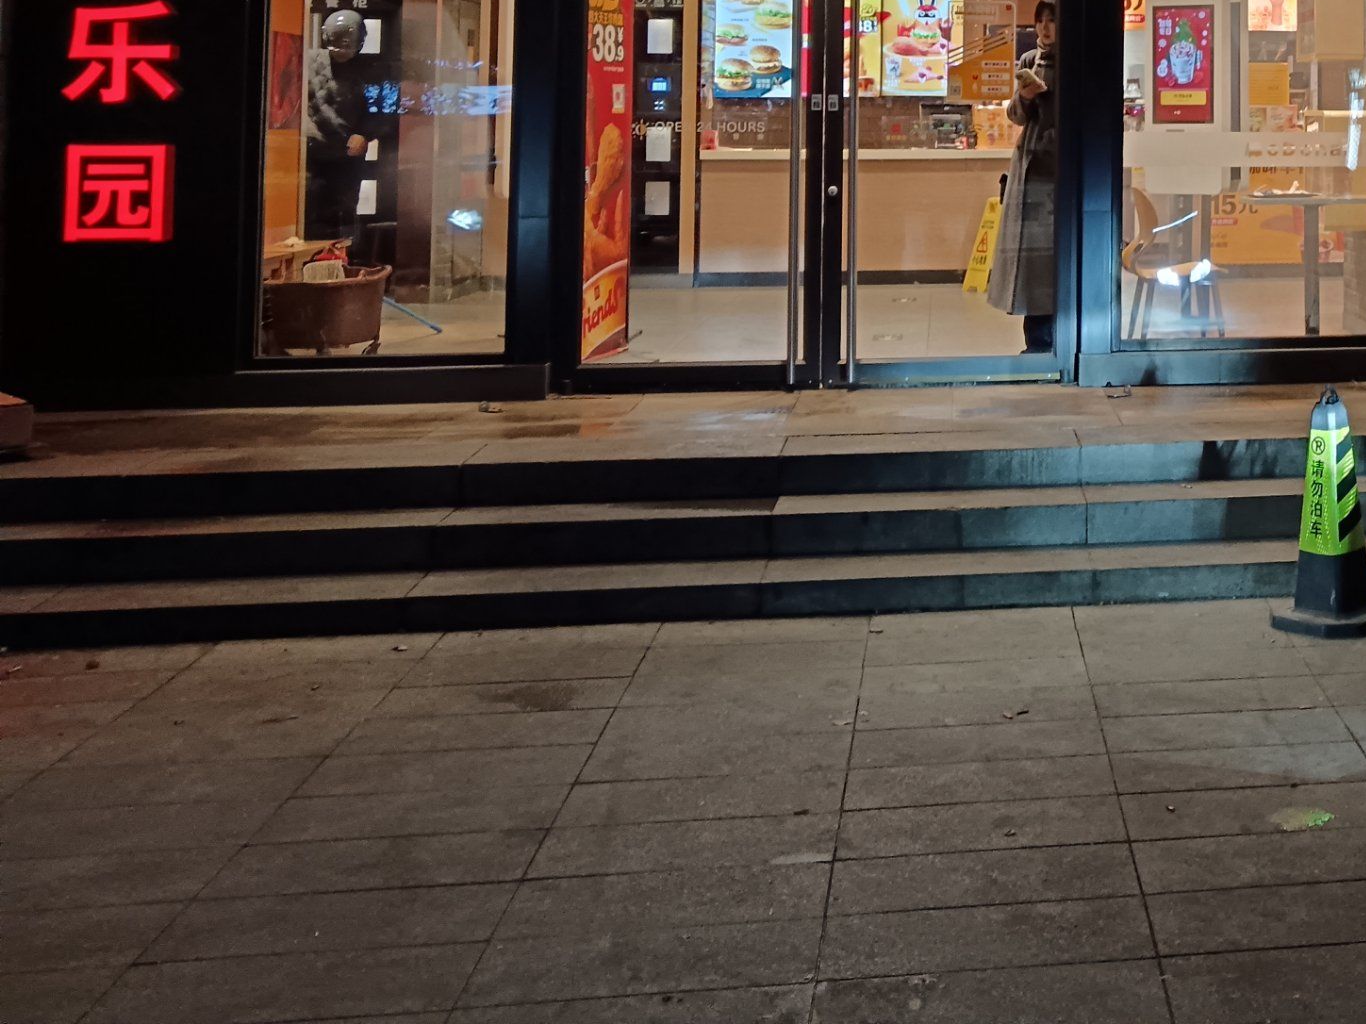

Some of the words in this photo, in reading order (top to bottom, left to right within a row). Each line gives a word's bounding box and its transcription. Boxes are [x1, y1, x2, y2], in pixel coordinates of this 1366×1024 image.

[719, 121, 766, 133] HOURS
[1309, 459, 1325, 539] 请勿泊车
